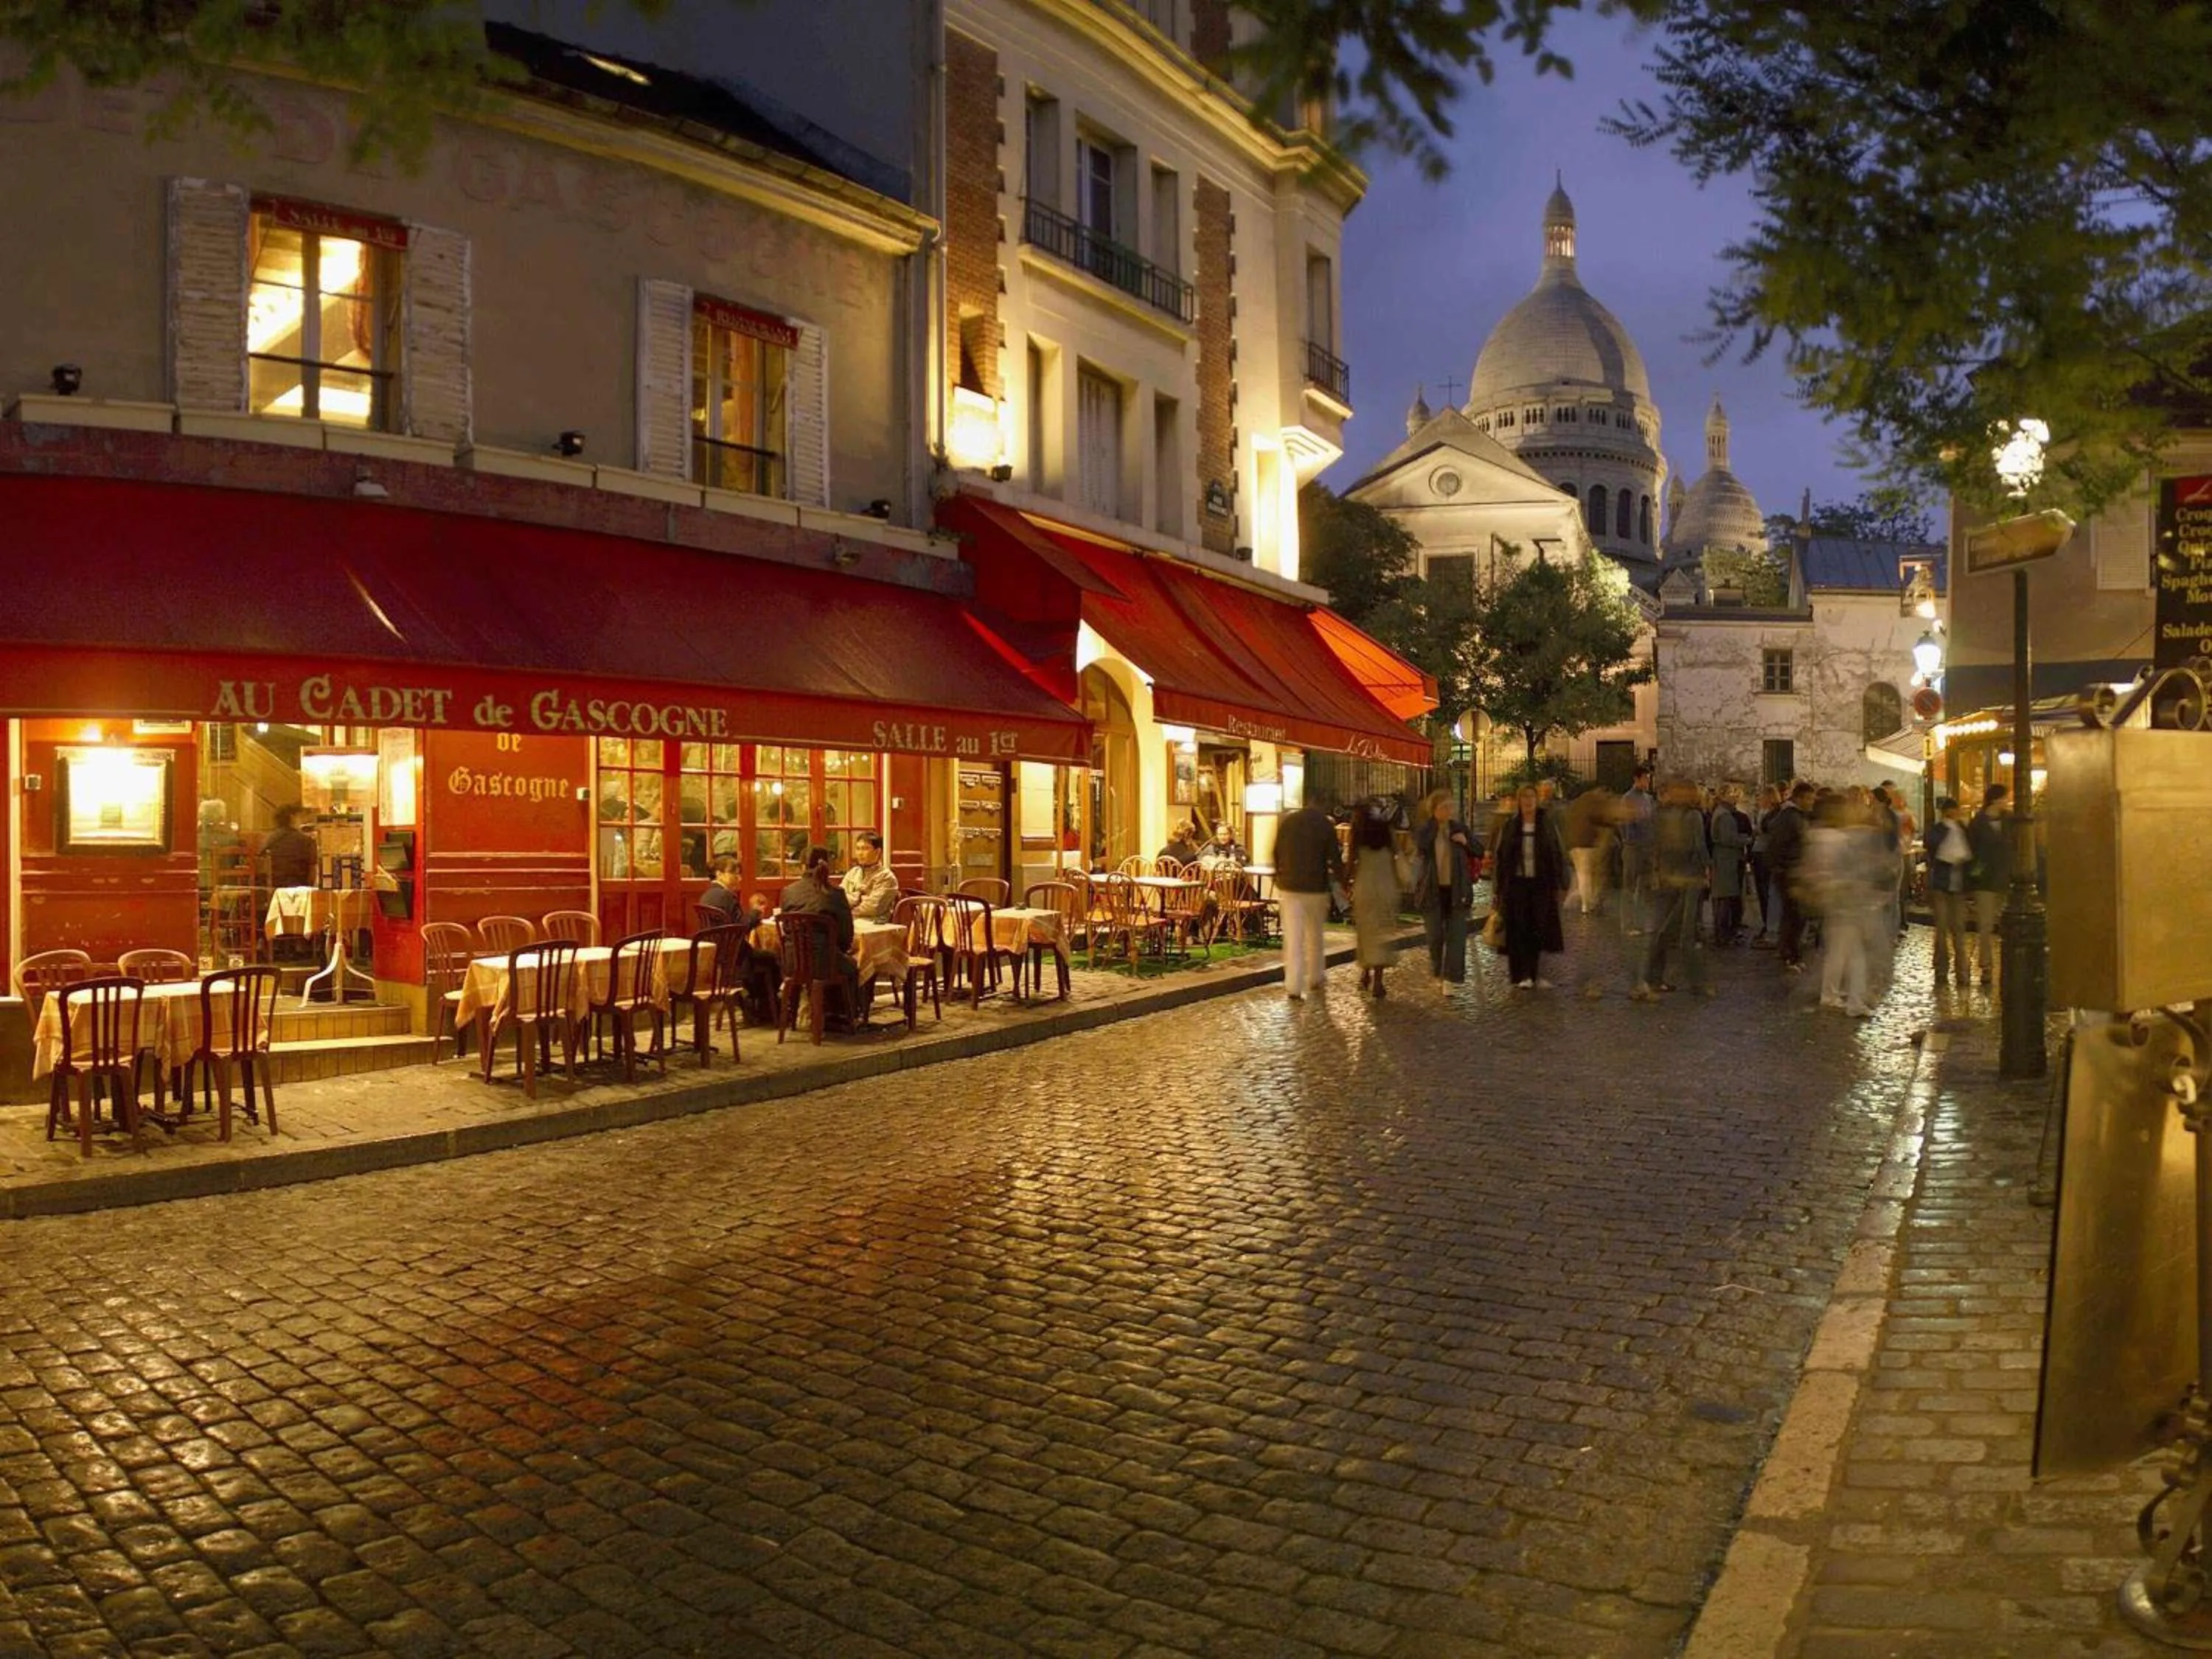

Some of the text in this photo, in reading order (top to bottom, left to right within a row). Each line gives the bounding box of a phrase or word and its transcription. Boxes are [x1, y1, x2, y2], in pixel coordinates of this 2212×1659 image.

[209, 672, 729, 737] AU CADET de GASCOGNE
[872, 720, 1019, 756] SALLE au 1er
[448, 765, 569, 803] Gascogne
